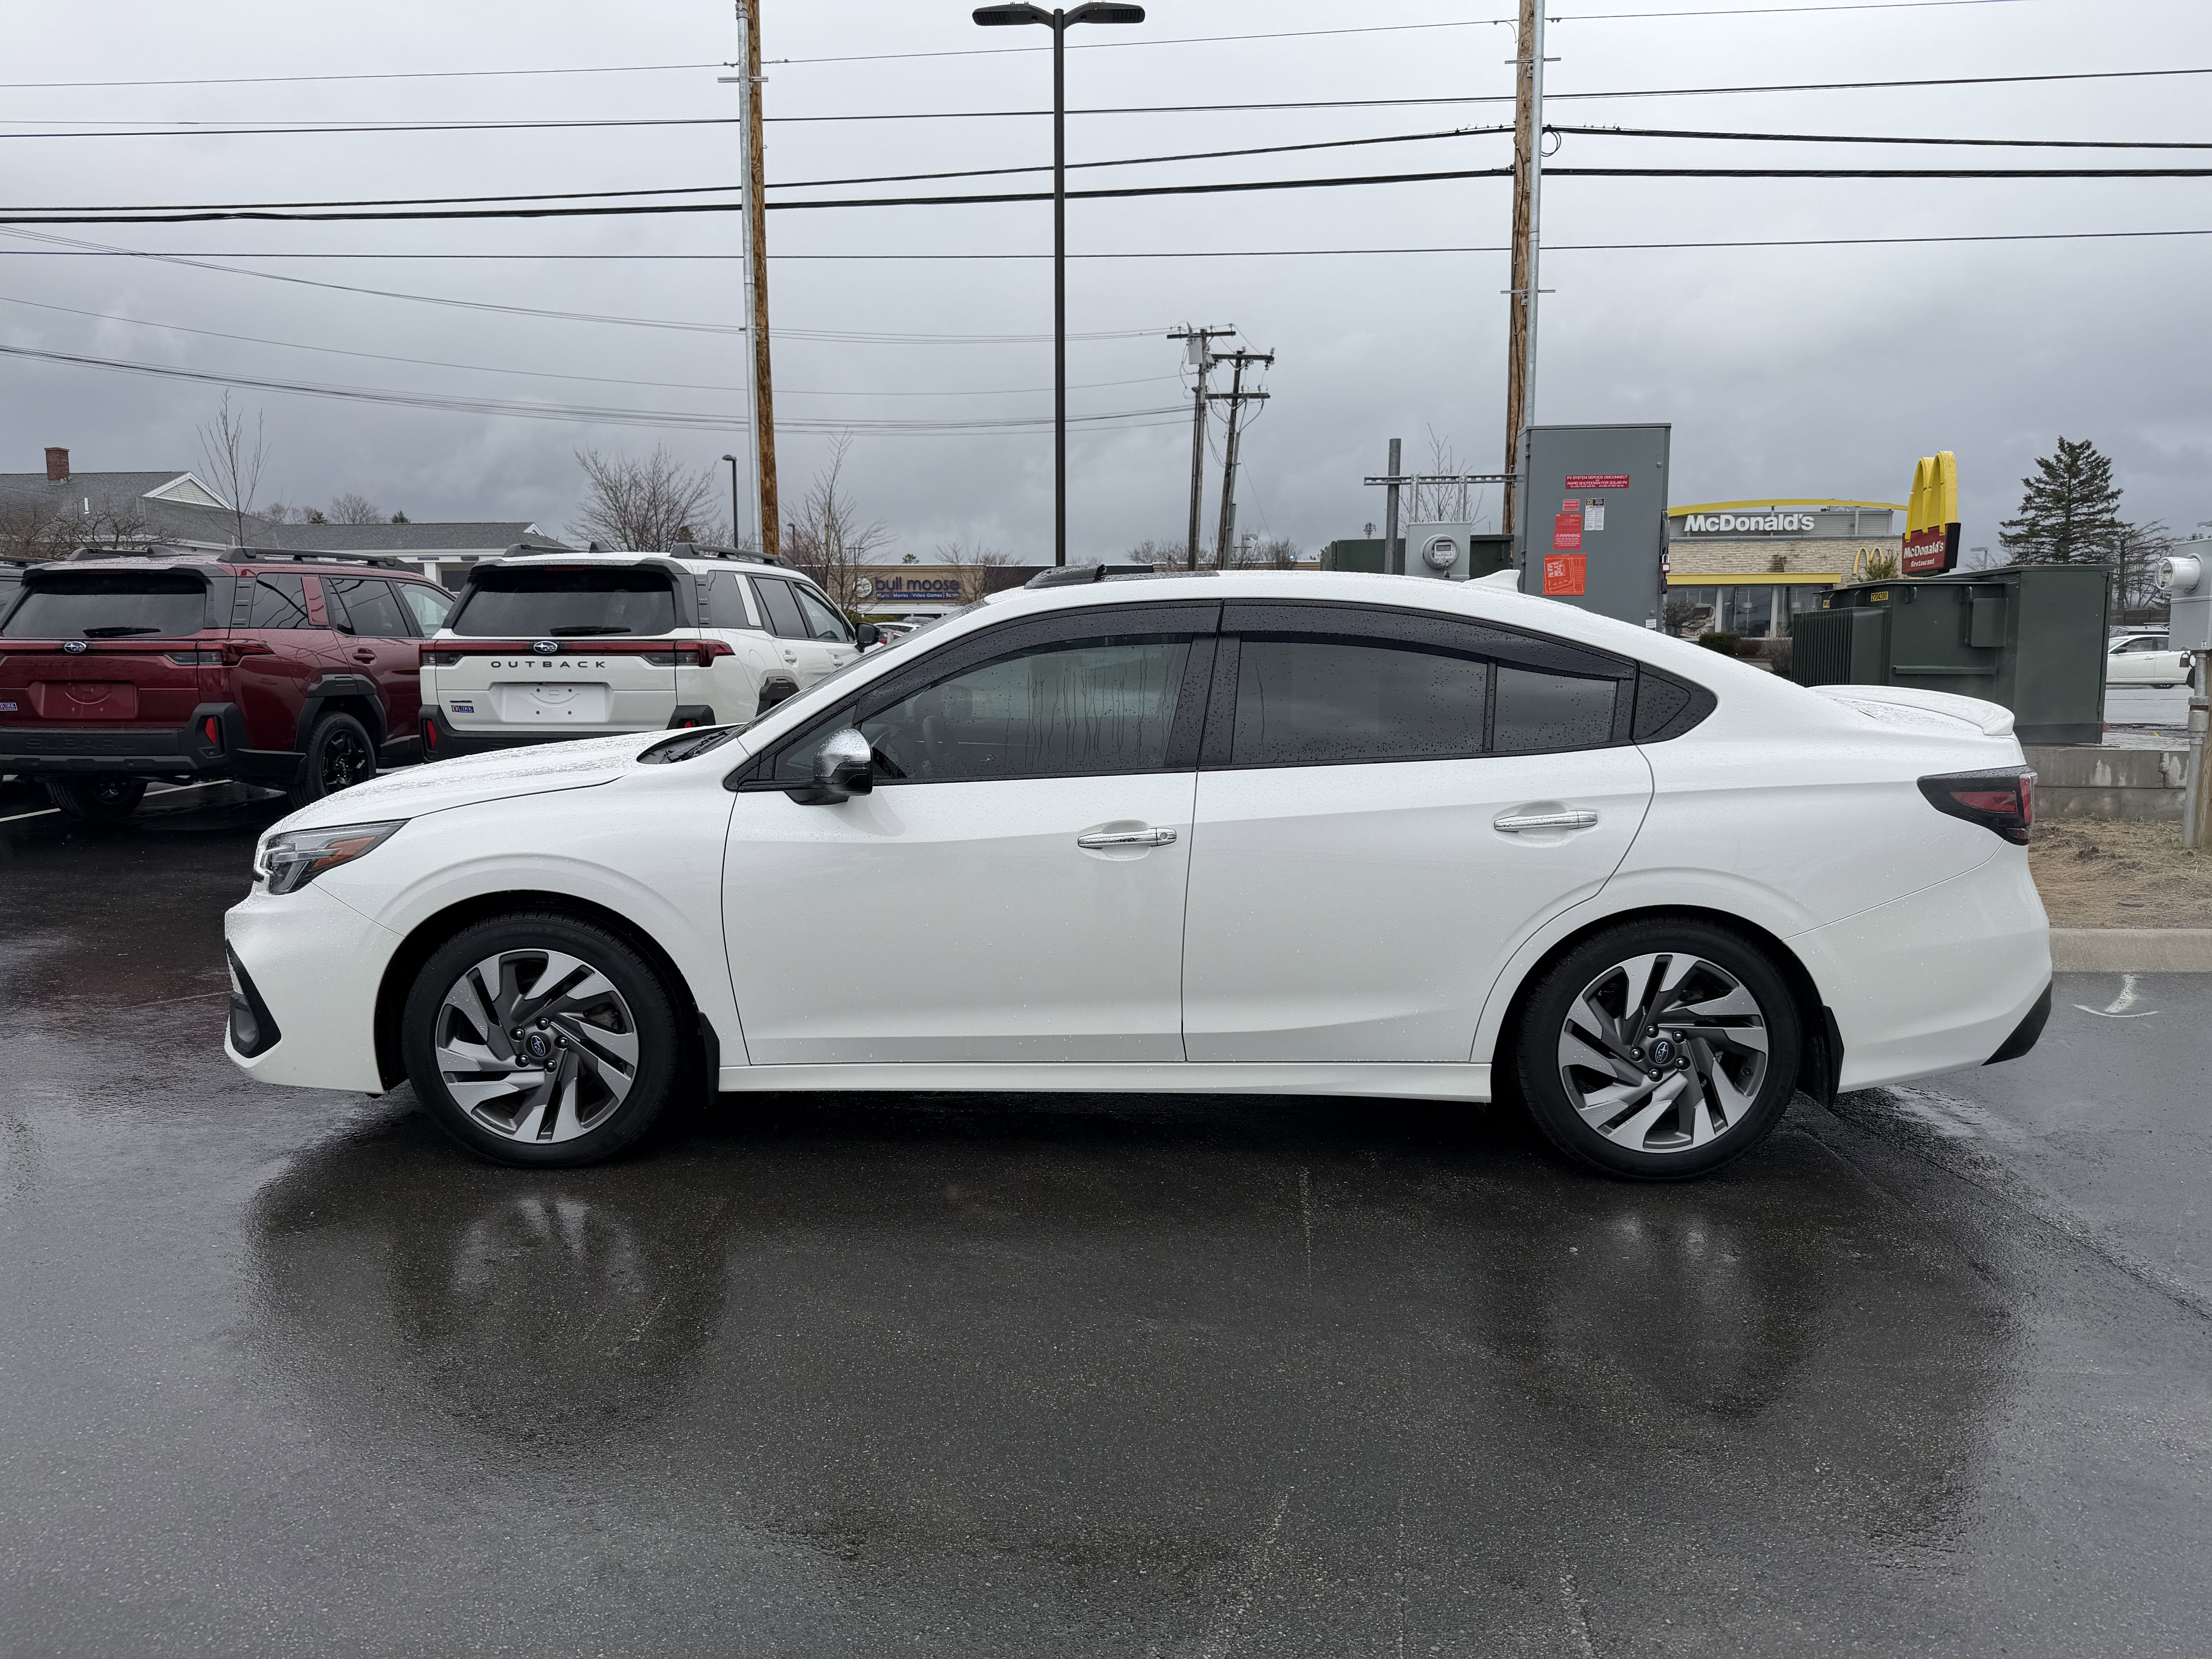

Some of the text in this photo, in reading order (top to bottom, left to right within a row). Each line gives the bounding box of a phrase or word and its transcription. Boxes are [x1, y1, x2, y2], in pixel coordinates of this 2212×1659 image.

[1684, 514, 1815, 532] McDonald's
[1903, 541, 1944, 559] McDonald's
[1911, 558, 1934, 567] Restaurant
[875, 576, 960, 591] bull moose
[26, 738, 136, 750] SUBARU
